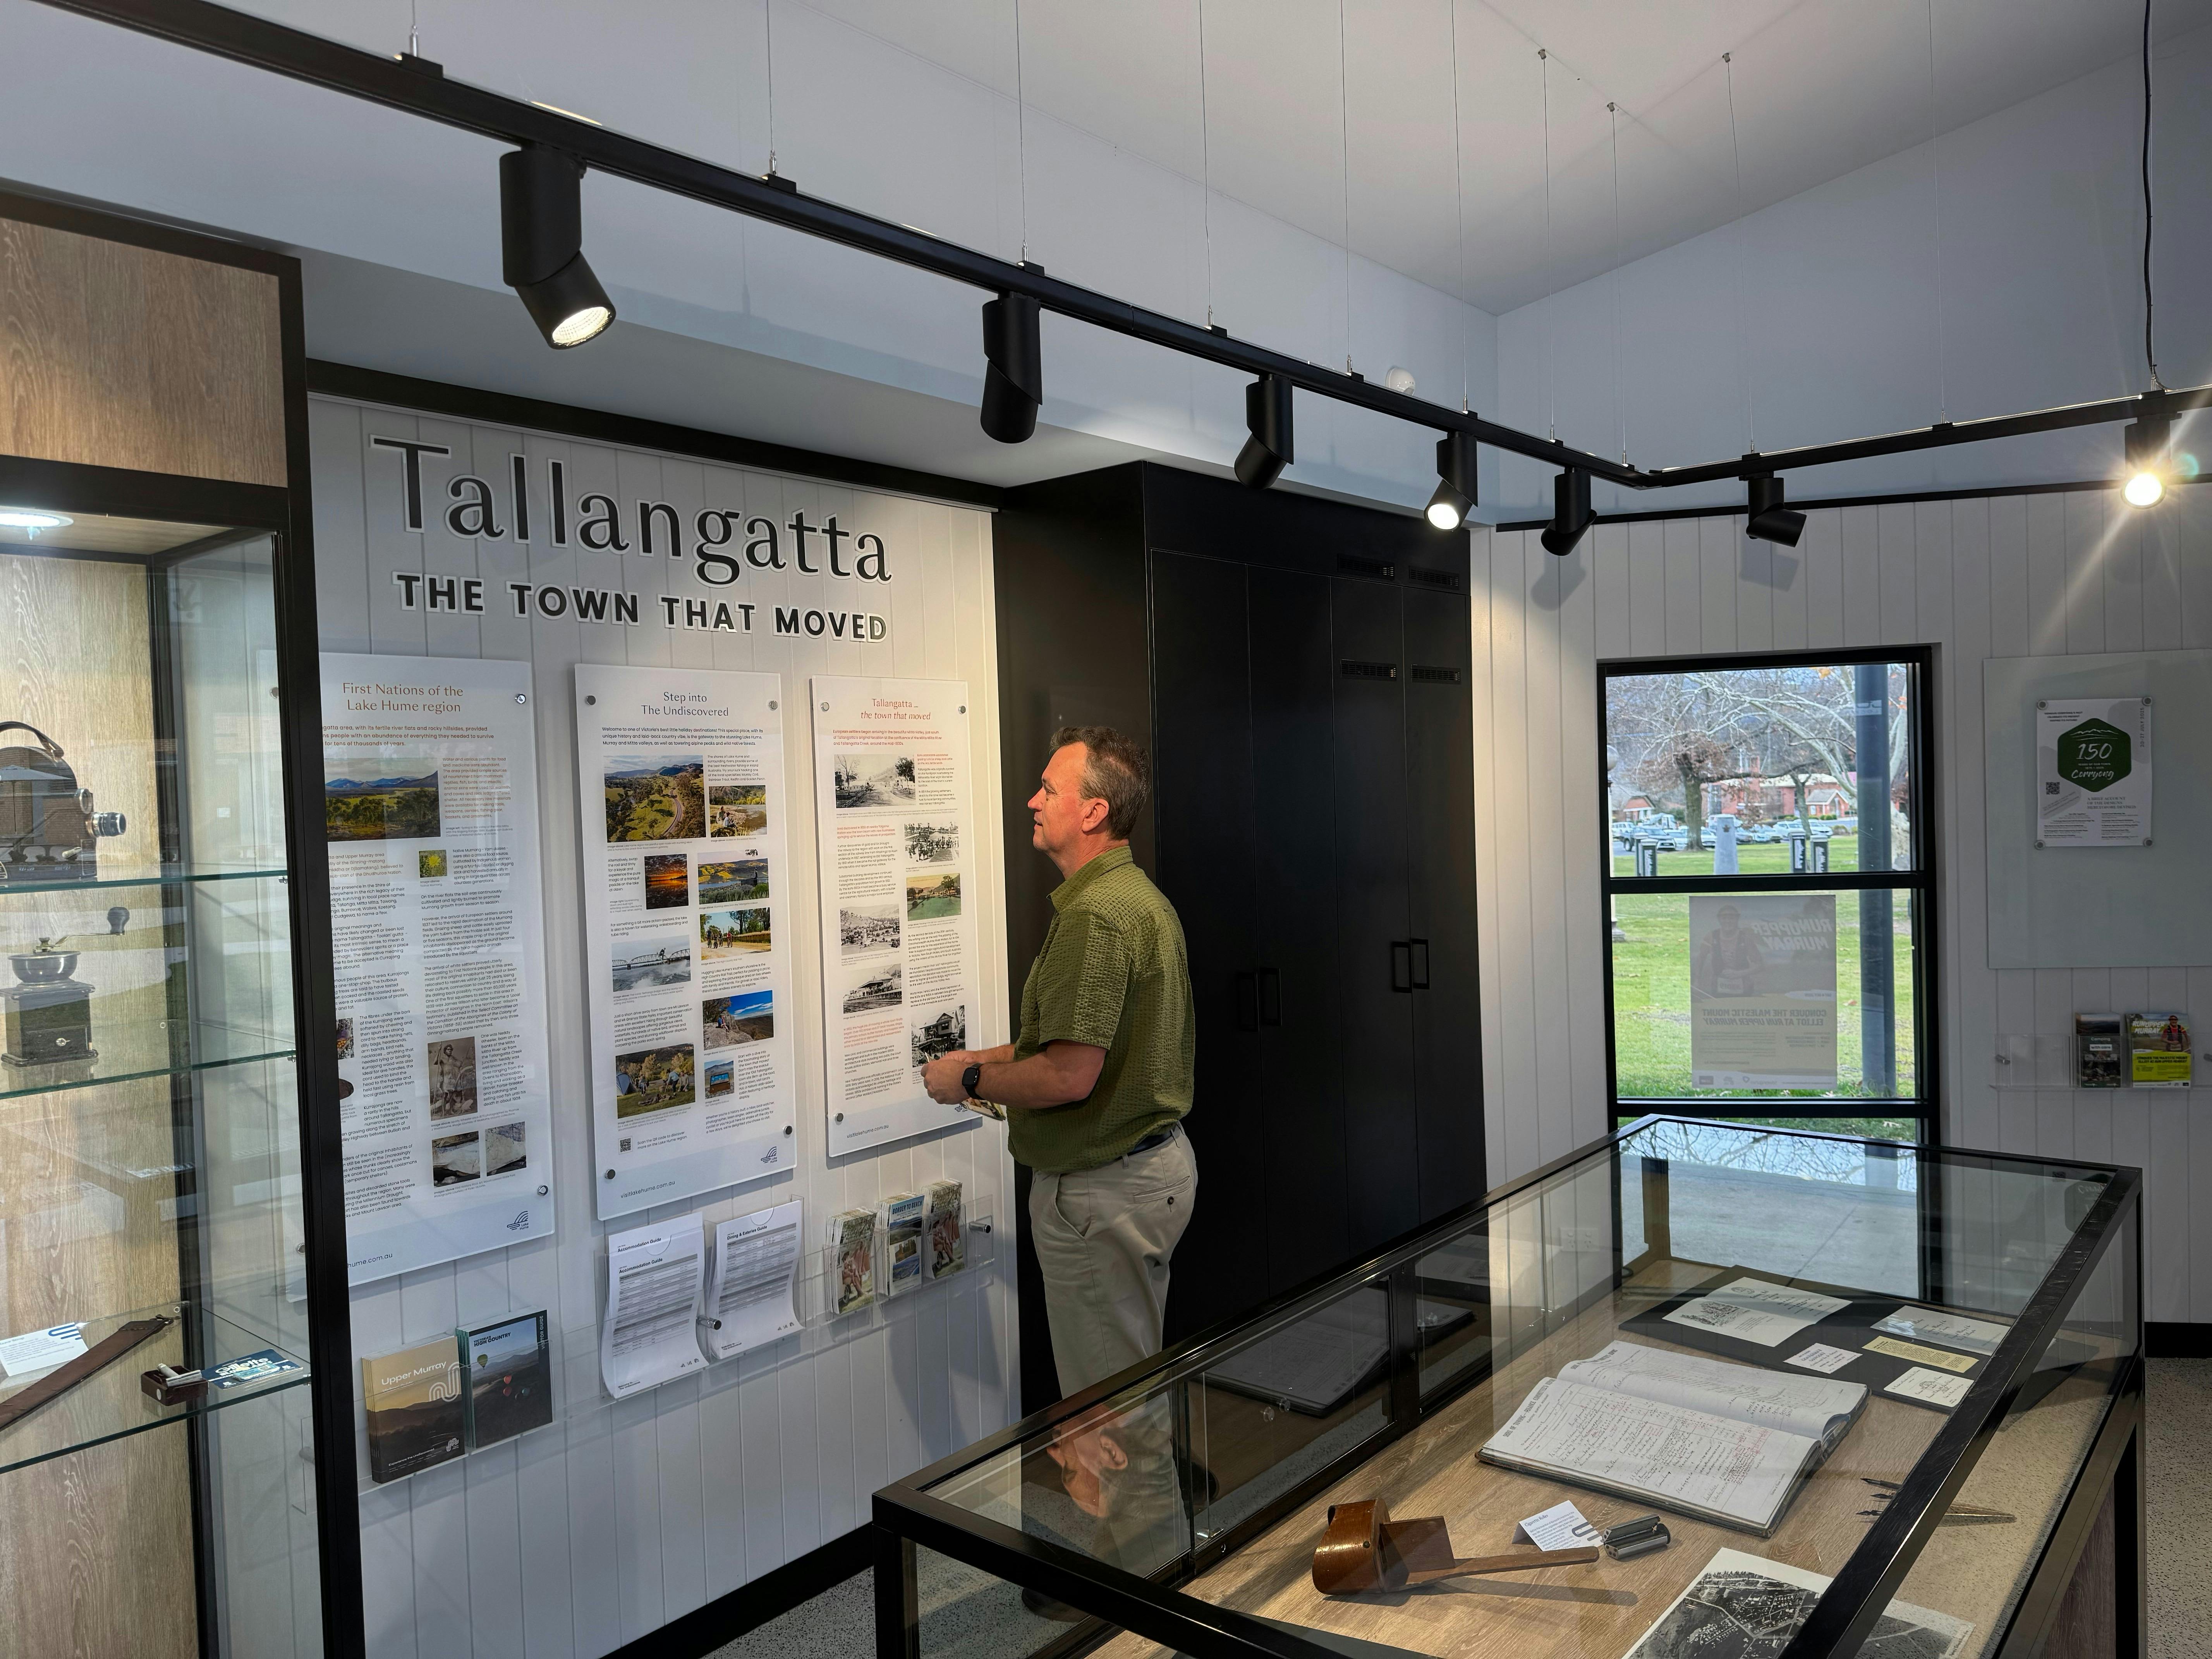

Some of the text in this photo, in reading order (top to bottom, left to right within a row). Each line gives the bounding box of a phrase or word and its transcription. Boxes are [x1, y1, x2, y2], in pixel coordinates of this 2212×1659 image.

[372, 436, 893, 586] Tallangatta
[395, 573, 888, 641] THE TOWN THAT MOVED
[343, 683, 464, 696] First Nations of the
[664, 692, 707, 704] Step into
[347, 699, 461, 714] Lake Hume region
[641, 705, 728, 716] The Undiscovered
[861, 711, 872, 719] the
[894, 711, 907, 720] that
[2076, 742, 2113, 760] 150
[2071, 769, 2114, 780] Corryong
[621, 1181, 675, 1198] visitlakehume.com.au
[892, 1205, 906, 1214] BORDER
[911, 1200, 922, 1208] BEACH
[618, 1241, 649, 1252] Accommodation
[619, 1262, 651, 1274] Accommodation
[488, 1332, 511, 1343] COUNTRY
[215, 1358, 269, 1373] Gillette
[381, 1361, 447, 1385] Upper Murray
